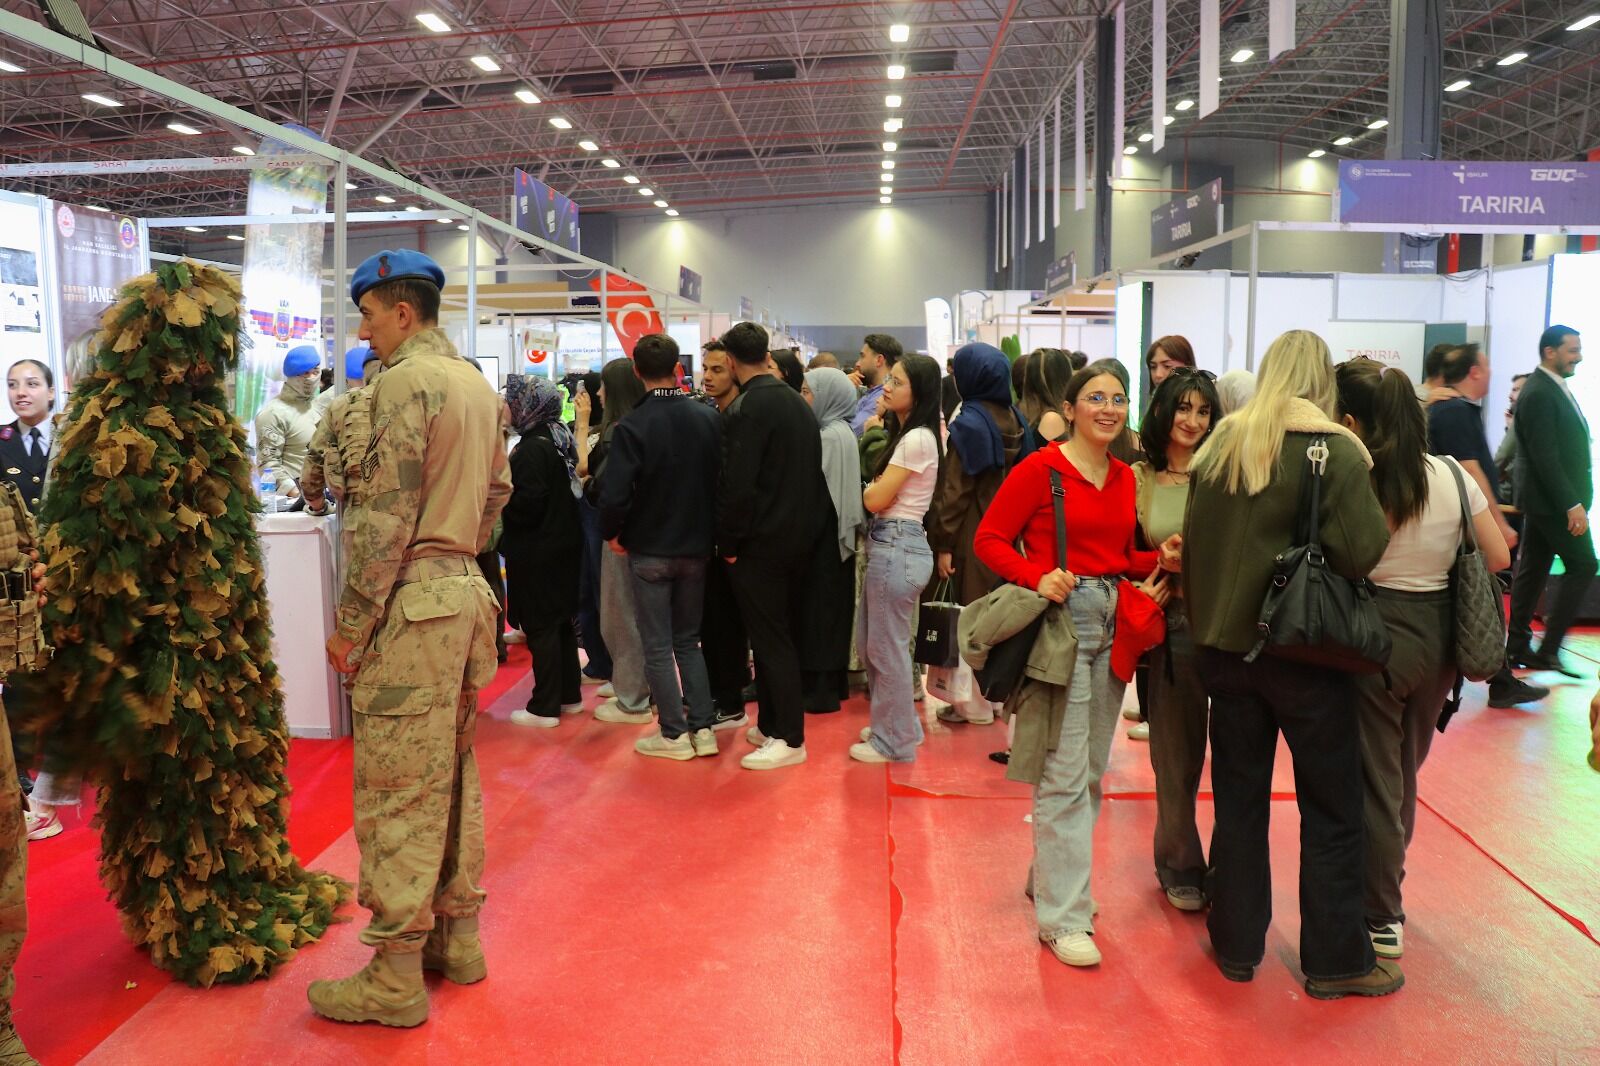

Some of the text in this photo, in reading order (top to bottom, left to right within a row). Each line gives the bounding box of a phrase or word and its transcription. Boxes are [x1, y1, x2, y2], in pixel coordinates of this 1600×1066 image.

[1458, 195, 1545, 214] TARIRIA
[88, 285, 114, 303] JAND
[654, 388, 682, 397] HILFIG
